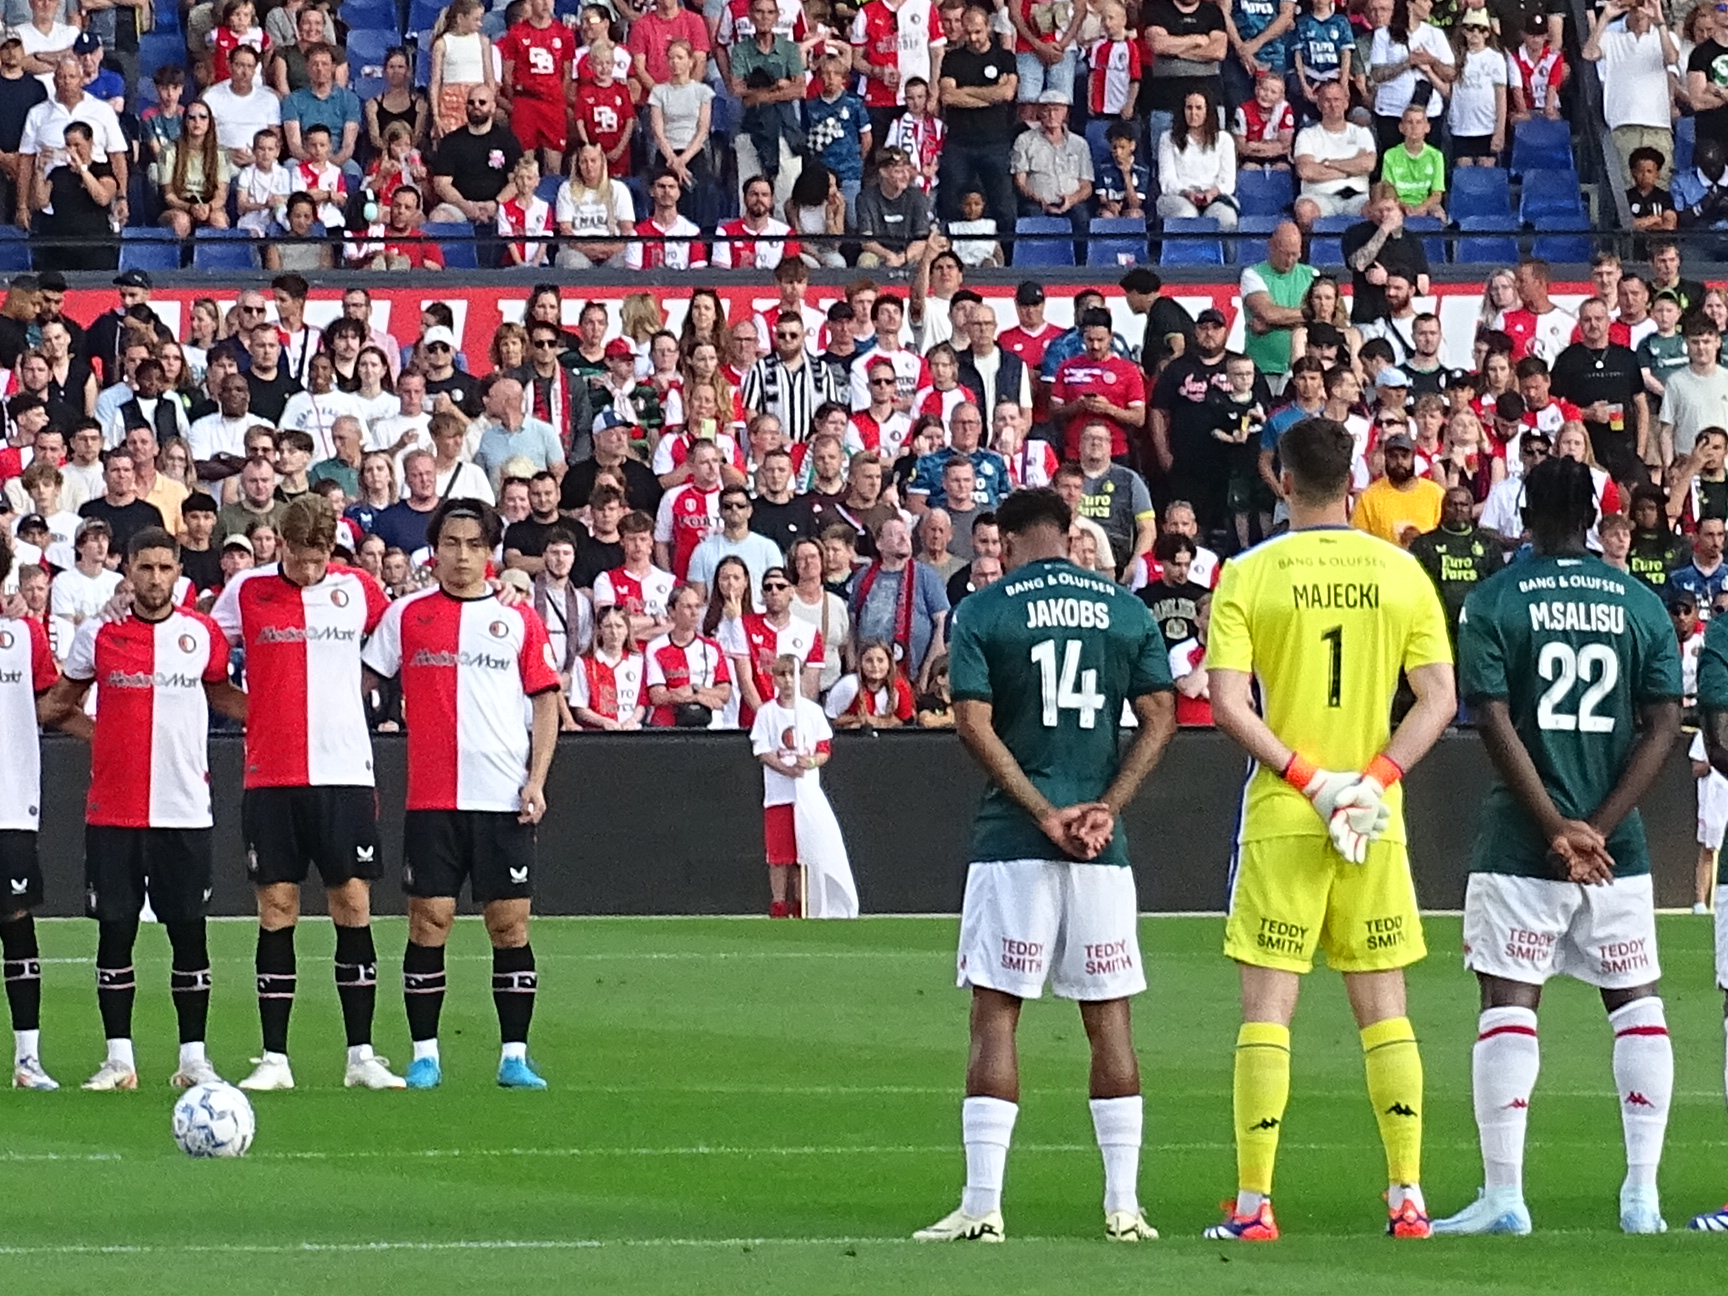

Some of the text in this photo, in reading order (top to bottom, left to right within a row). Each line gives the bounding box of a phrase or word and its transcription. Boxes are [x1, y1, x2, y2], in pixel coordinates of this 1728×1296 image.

[1005, 577, 1044, 596] BANG
[1519, 576, 1556, 593] BANG
[1292, 583, 1380, 609] MAJECKI
[1027, 598, 1110, 630] JAKOBS
[1529, 602, 1624, 634] M.SALISU
[1320, 624, 1343, 708] 1
[1031, 639, 1106, 729] 14
[1537, 641, 1618, 733] 22
[1260, 917, 1309, 939] TEDDY
[1365, 915, 1403, 934] TEDD
[1256, 933, 1305, 954] SMITH
[1508, 928, 1555, 948] TEDDY
[1598, 938, 1646, 956] TEDDY
[1600, 954, 1649, 974] SMITH
